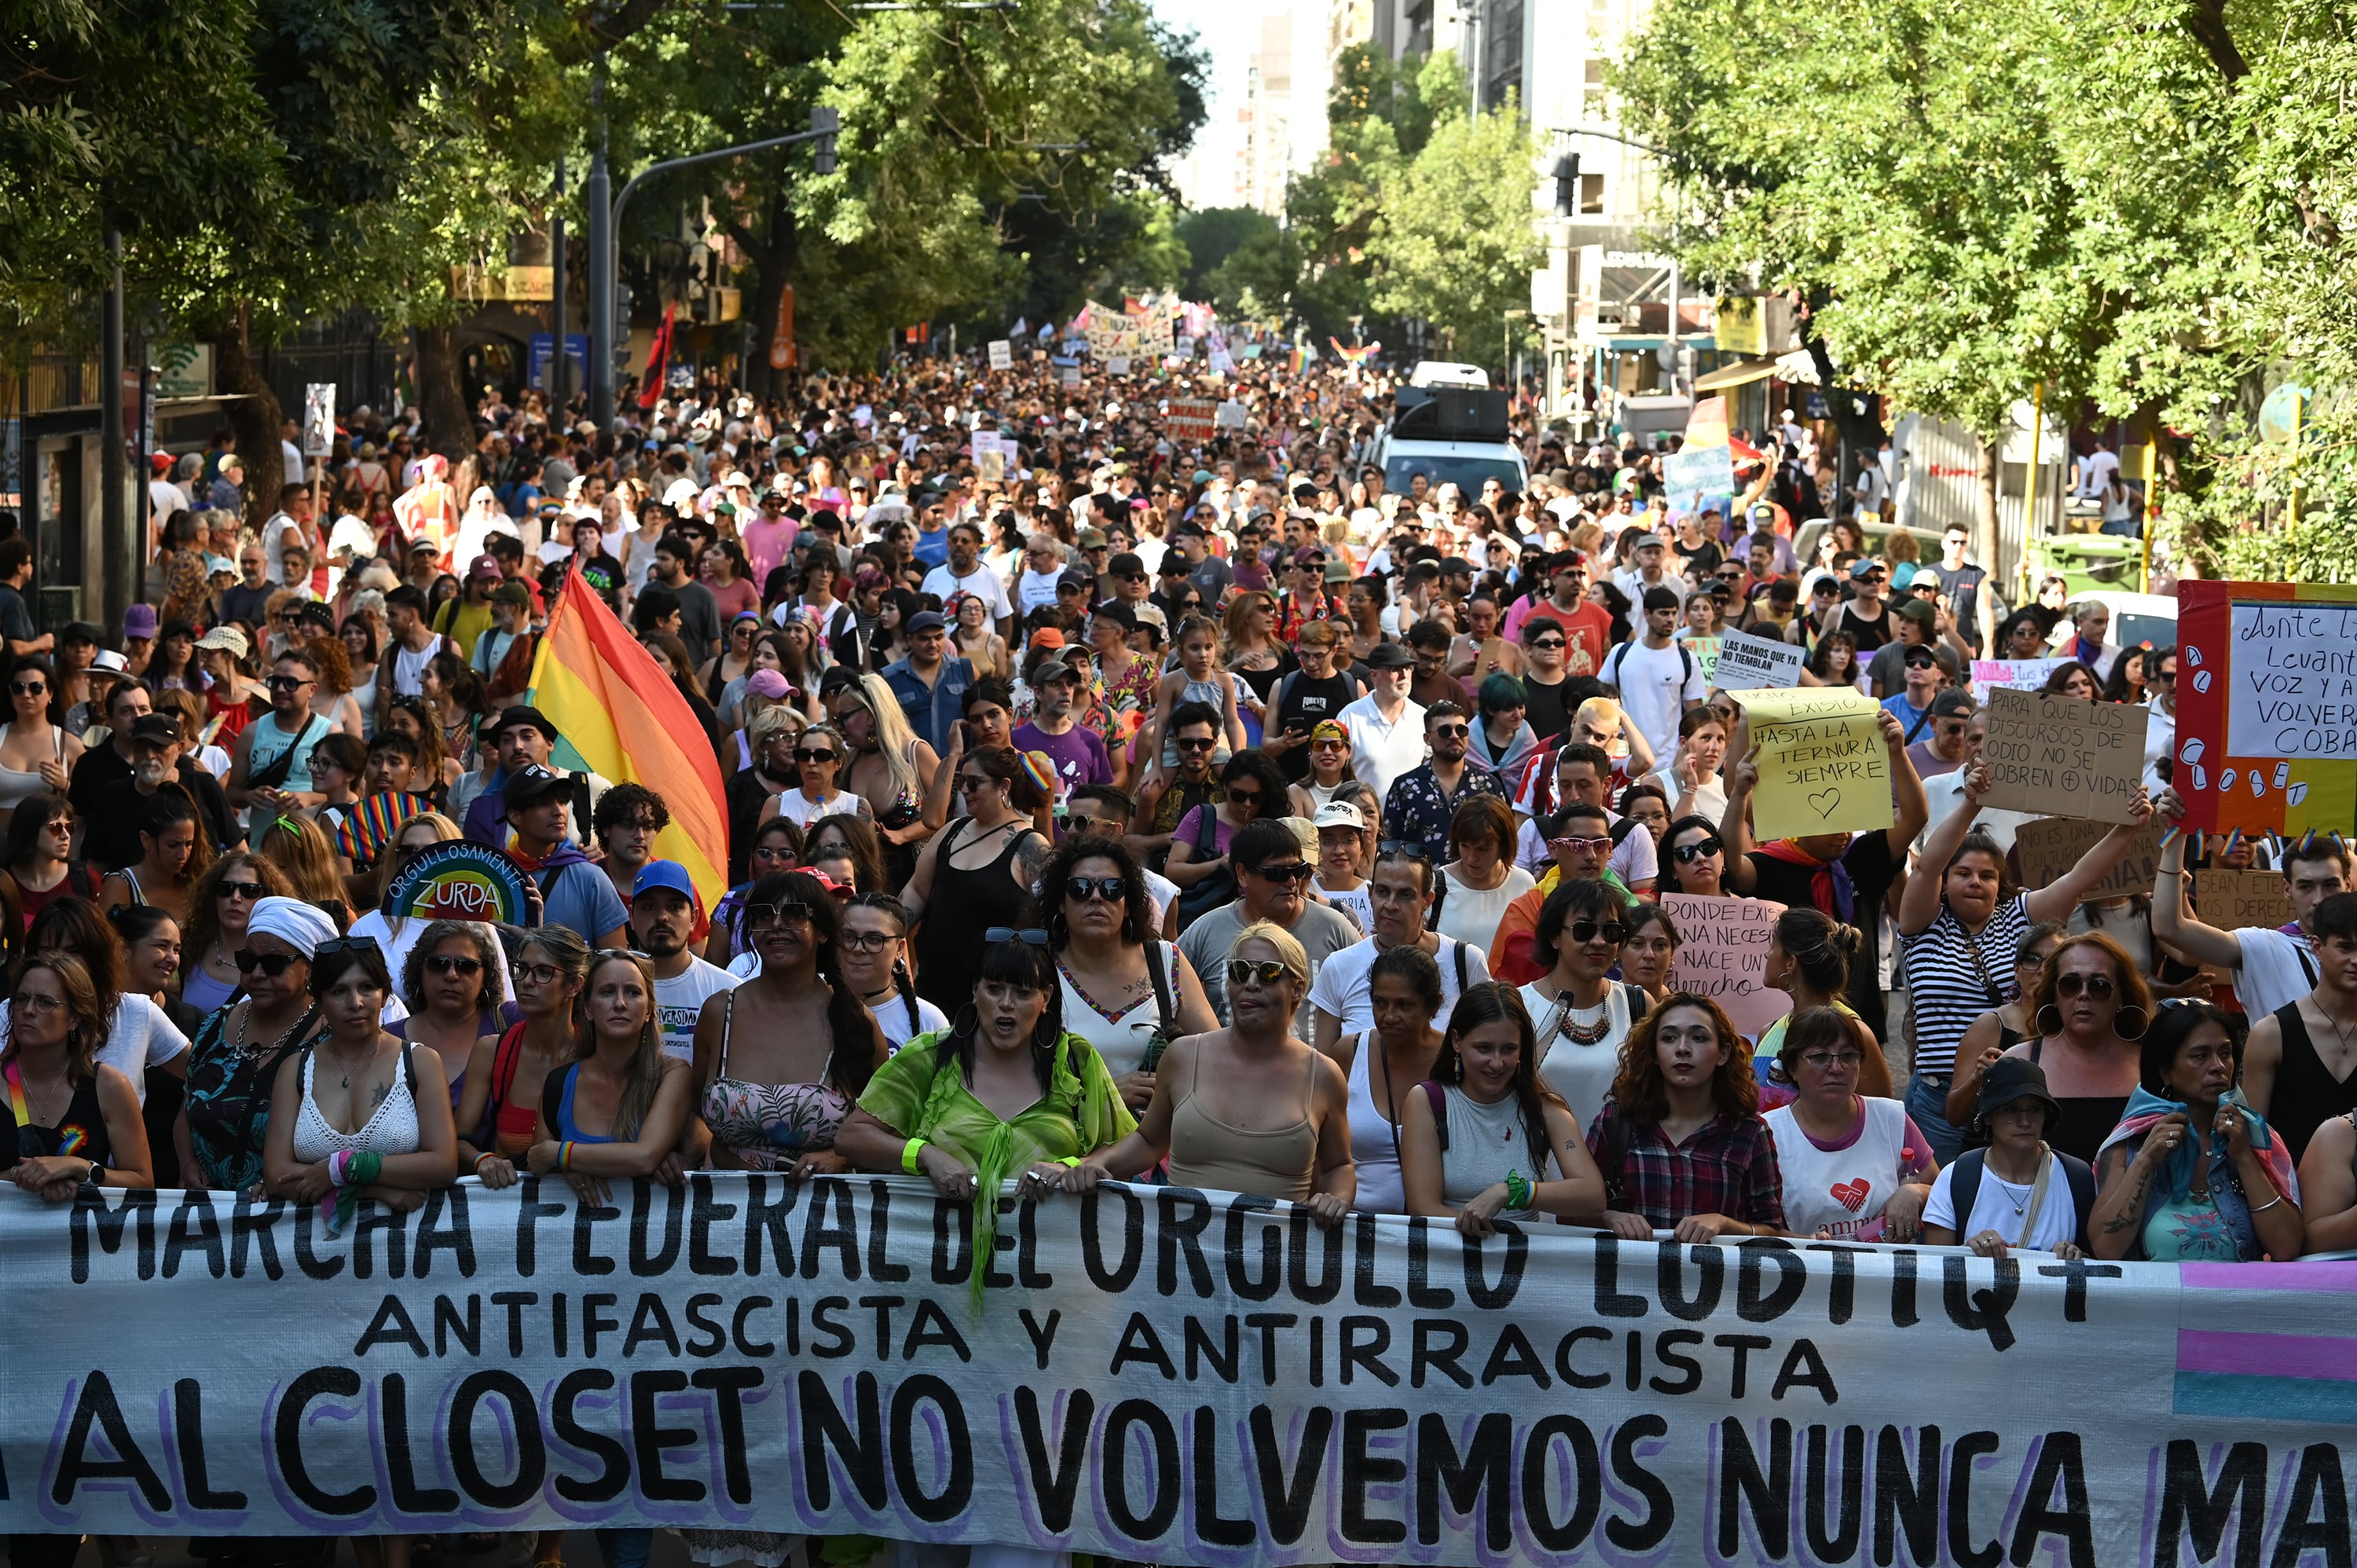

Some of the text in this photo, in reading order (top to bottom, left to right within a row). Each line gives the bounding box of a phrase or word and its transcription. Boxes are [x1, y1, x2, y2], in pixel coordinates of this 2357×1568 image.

[2241, 607, 2325, 641] Ante
[1721, 650, 1732, 661] NO
[1735, 652, 1773, 672] TIEMBLAN
[1724, 639, 1798, 666] LAS MANOS QUE YA
[2249, 671, 2304, 694] VOZ
[2321, 678, 2330, 698] Y
[1990, 691, 2124, 729] PARA QUE LOS
[2257, 700, 2357, 727] VOLVER
[1754, 720, 1851, 745] HASTA LA
[1988, 716, 2125, 749] DISCURSOS DE
[1774, 736, 1877, 764] TERNURA
[1987, 740, 2096, 771] ODIO NO SE
[1786, 760, 1885, 785] SIEMPRE
[1986, 761, 2054, 788] COBREN
[2086, 775, 2143, 798] VIDAS
[2021, 830, 2040, 849] NO
[2047, 826, 2062, 844] ES
[2070, 823, 2096, 842] UNA
[388, 844, 526, 899] ORGULLOSAMENTE
[2024, 845, 2085, 872] CULTURA
[412, 879, 502, 916] ZURDA
[2199, 873, 2239, 895] SEAN
[1664, 900, 1736, 921] DONDE
[1674, 924, 1710, 944] NA
[1684, 948, 1734, 971] NACE
[1667, 971, 1763, 997] derecho
[657, 1008, 697, 1025] IVERSIDAD
[71, 1184, 477, 1284] MARCHA
[516, 1173, 911, 1282] FEDERAL
[931, 1196, 1054, 1289] DEL
[1080, 1180, 1530, 1310] ORGULLO
[354, 1291, 1839, 1406] ANTIFASCISTA Y ANTIRRACISTA
[51, 1369, 248, 1513] AL
[274, 1365, 765, 1516] CLOSET
[797, 1369, 974, 1522] NO
[1014, 1385, 1675, 1552] VOLVEMOS
[1718, 1416, 2097, 1568] NUNCA
